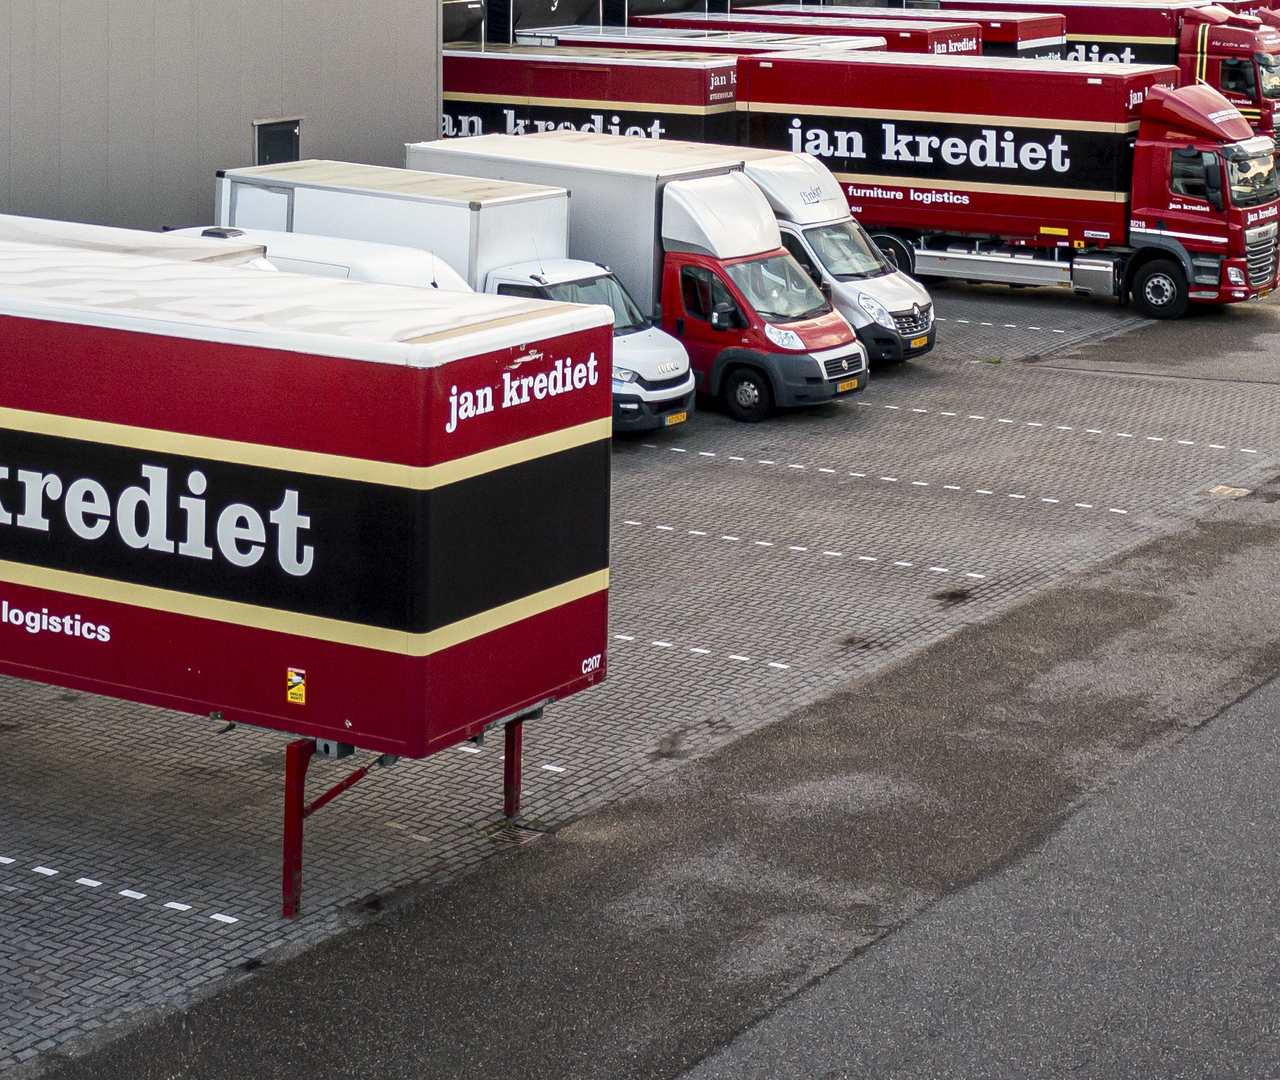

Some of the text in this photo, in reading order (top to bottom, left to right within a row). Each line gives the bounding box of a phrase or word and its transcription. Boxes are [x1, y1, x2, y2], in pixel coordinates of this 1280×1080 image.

[948, 37, 977, 53] krediet
[709, 73, 727, 90] jan
[1128, 89, 1143, 109] jan
[443, 113, 483, 137] an
[788, 118, 1070, 172] jan krediet
[847, 185, 970, 205] furniture logistics
[657, 362, 680, 375] IVECO
[445, 351, 599, 433] jan krediet
[1, 600, 111, 643] logistics
[581, 653, 602, 674] C207
